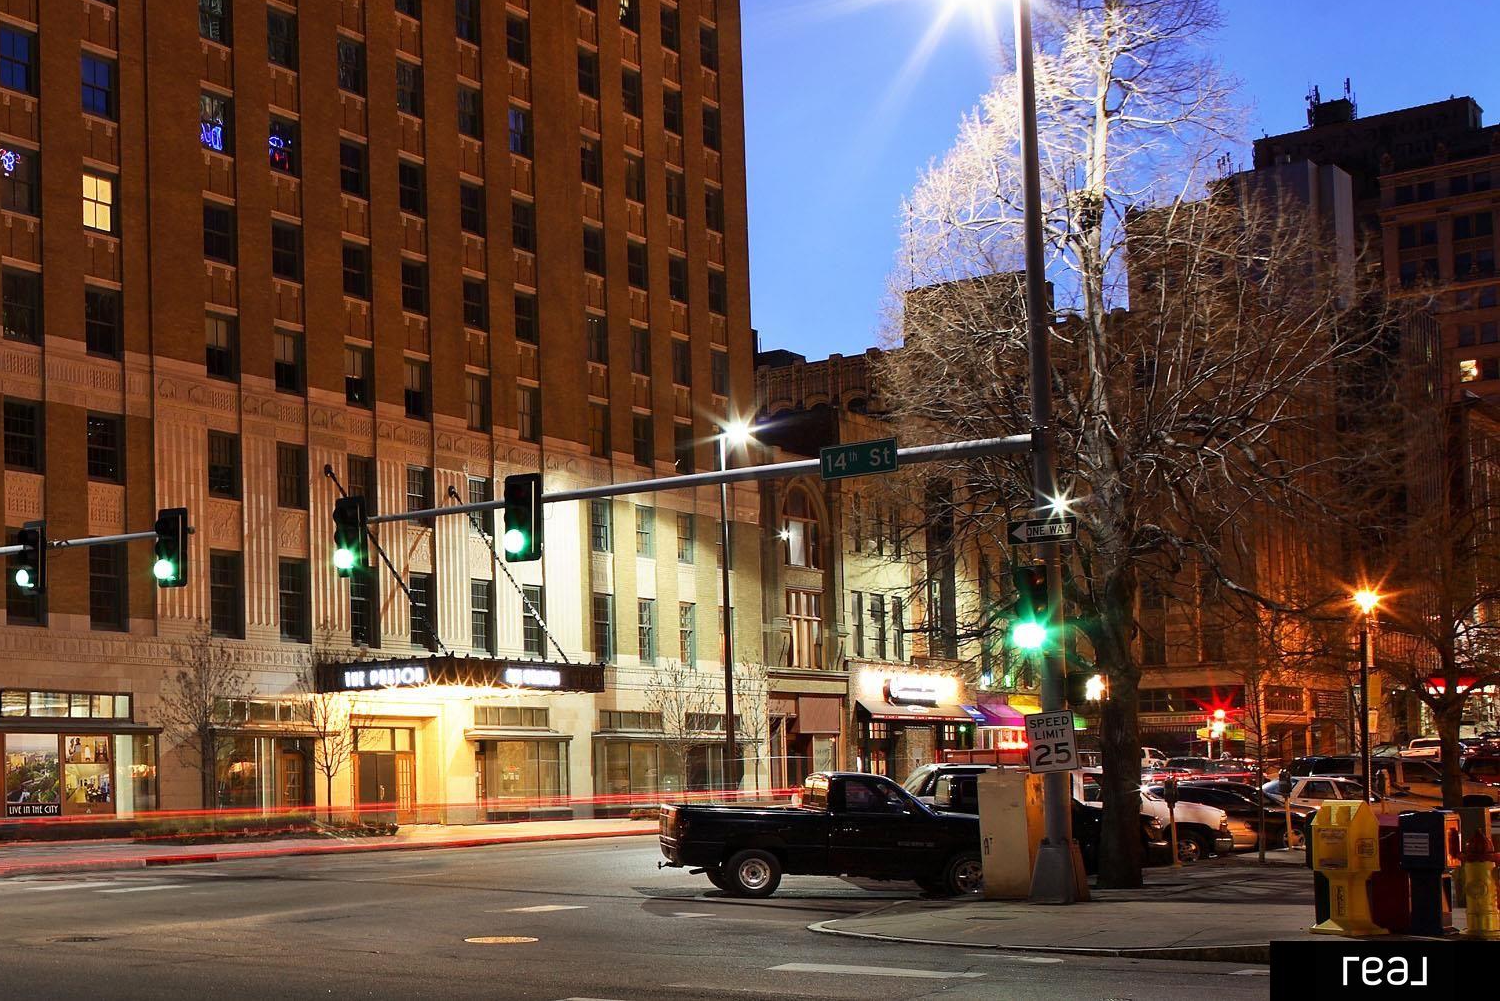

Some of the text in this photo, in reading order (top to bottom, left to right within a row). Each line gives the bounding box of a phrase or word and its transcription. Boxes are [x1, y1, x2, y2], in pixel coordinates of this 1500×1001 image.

[826, 446, 891, 472] 14th St
[1027, 524, 1070, 536] ONE WAY
[1030, 716, 1069, 728] SPEED
[1035, 728, 1066, 740] LIMIT
[1034, 742, 1071, 766] 25
[9, 805, 58, 814] LIVE IN THE CITY
